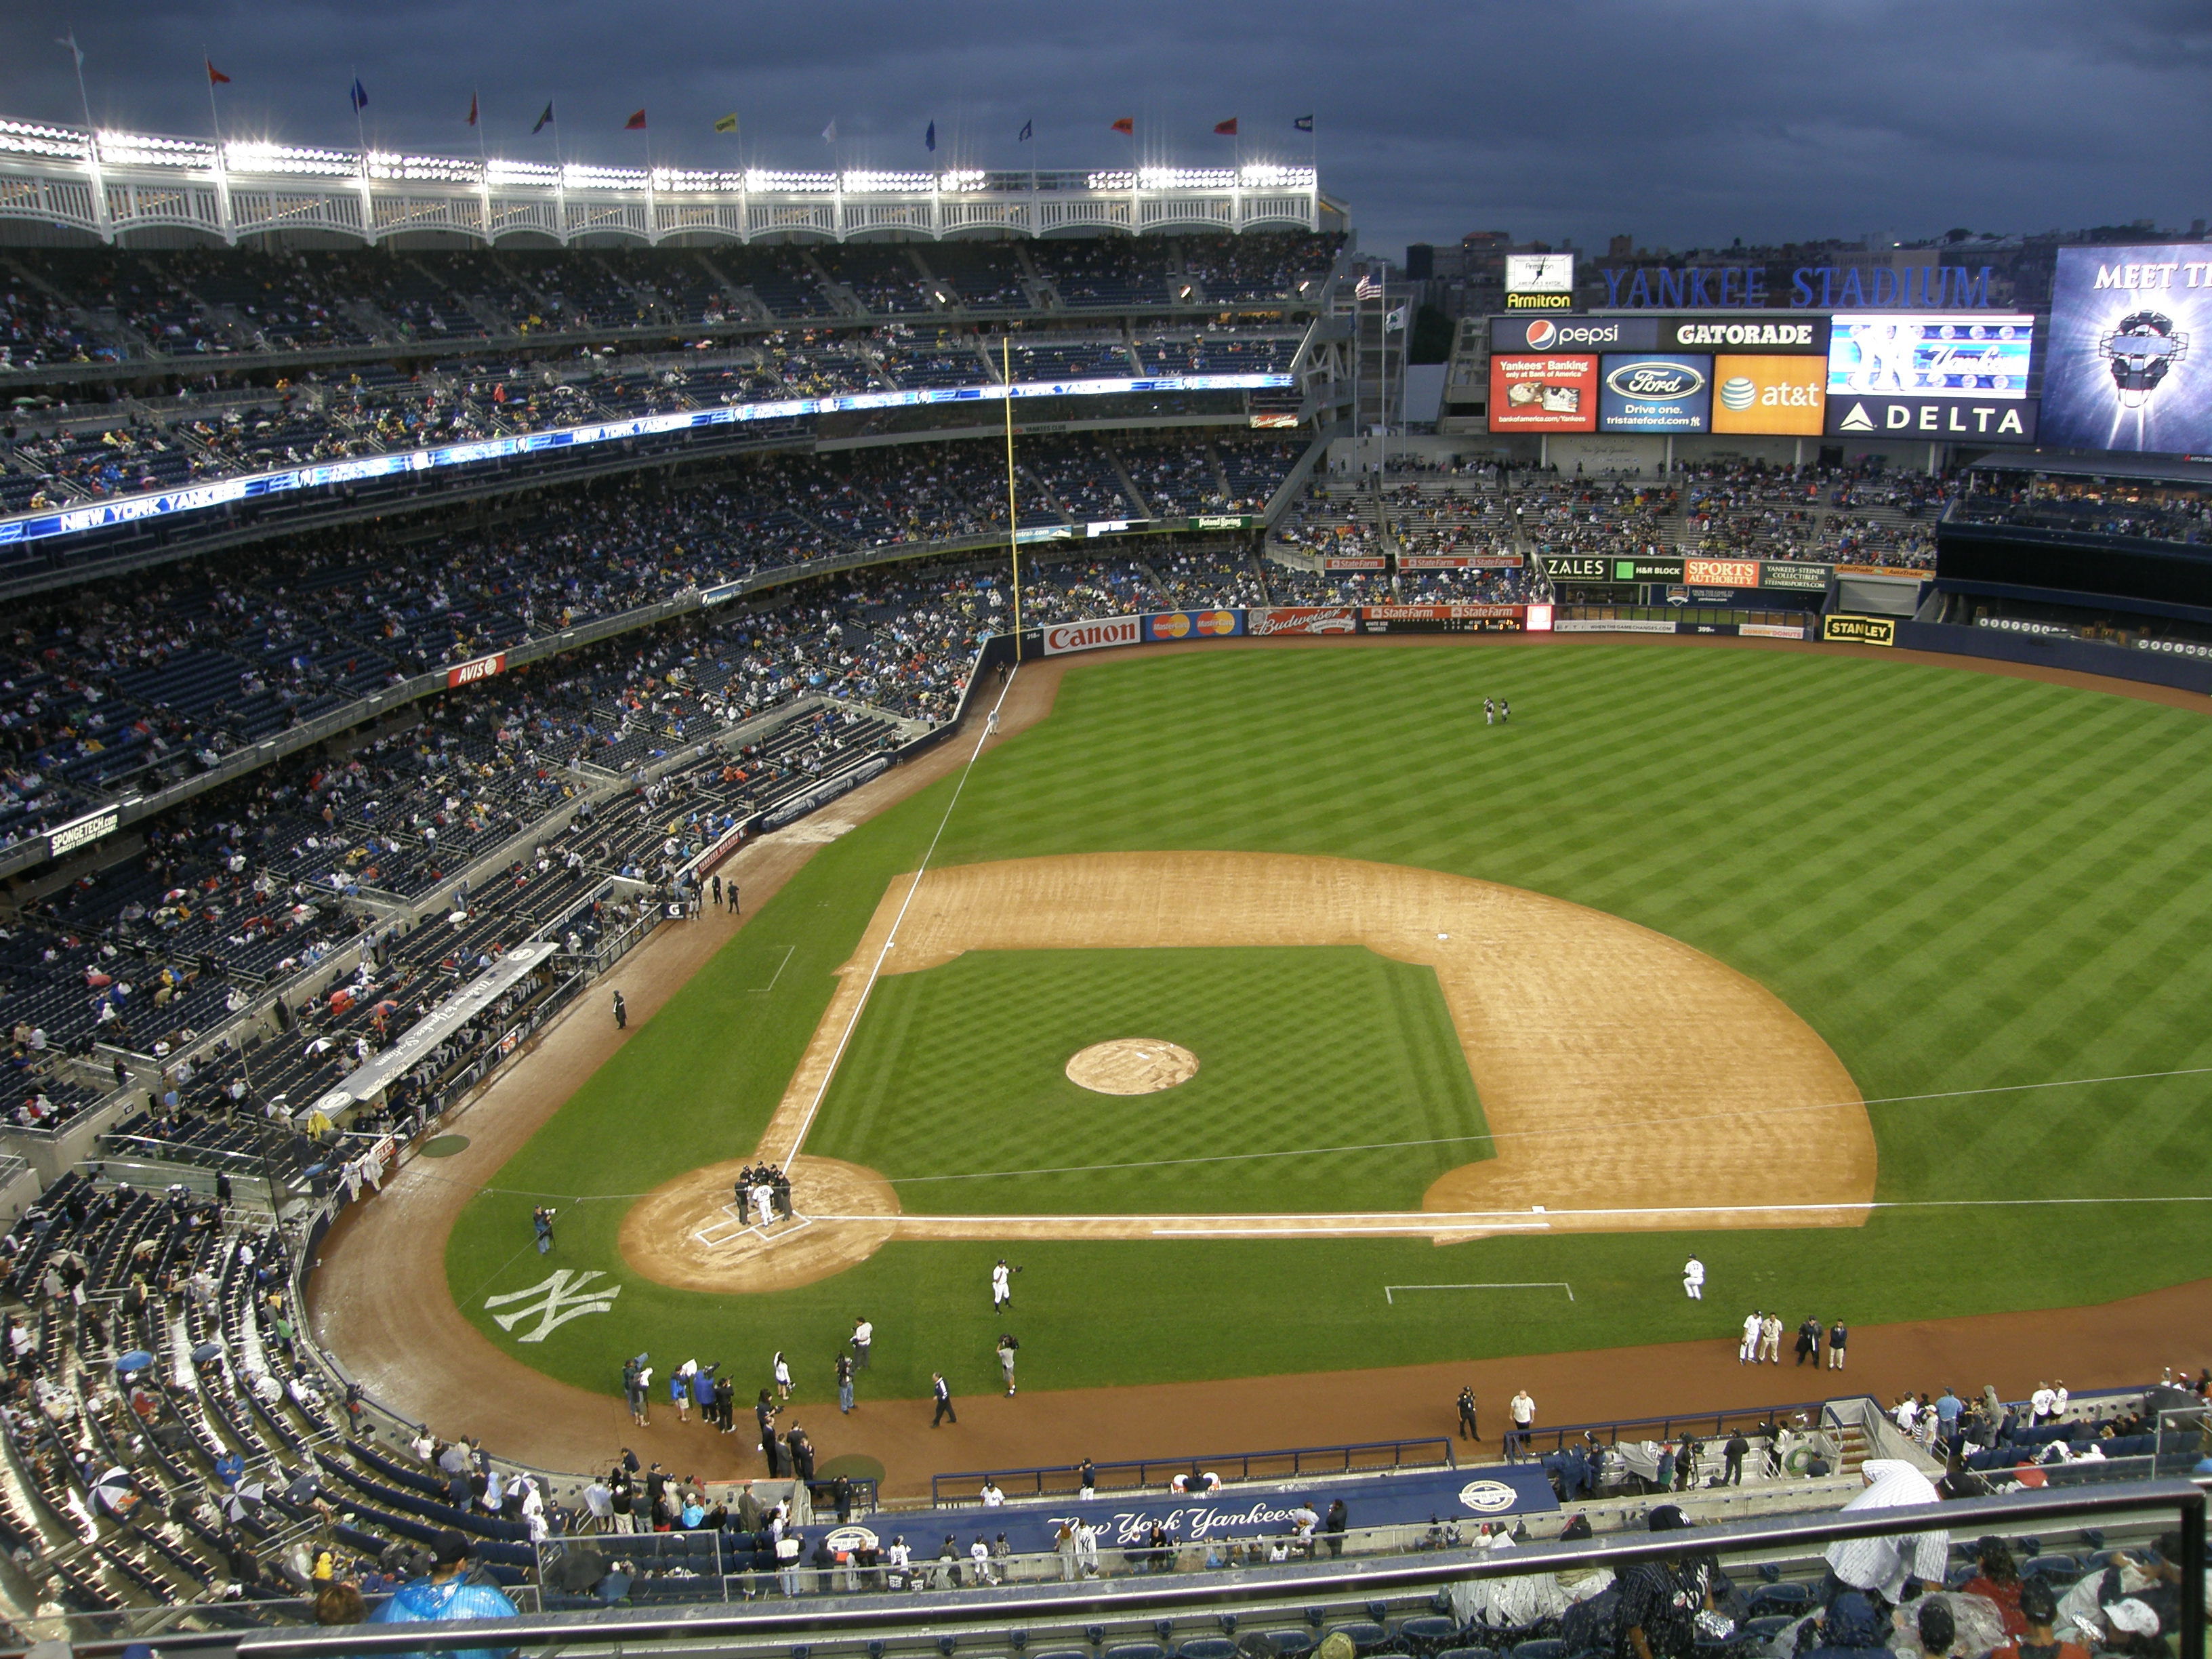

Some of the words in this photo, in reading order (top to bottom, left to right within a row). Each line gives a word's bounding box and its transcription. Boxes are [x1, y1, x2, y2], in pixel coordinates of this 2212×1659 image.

[2093, 263, 2179, 290] MEET
[1601, 268, 1765, 309] YANKEE
[1790, 266, 1993, 309] STADIUM
[1507, 293, 1571, 308] Armitron
[1559, 325, 1619, 346] pepsi
[1677, 325, 1812, 345] GATORADE
[1547, 360, 1589, 372] Banking
[1506, 371, 1519, 379] only
[1629, 369, 1682, 392] Ford
[1762, 382, 1819, 407] at&t
[1625, 405, 1656, 414] Drive
[1658, 406, 1683, 414] one.
[1498, 415, 1586, 424] bankofamerica.com/Yankees
[1606, 416, 1689, 425] tristateford.com
[1887, 405, 2024, 434] DELTA
[61, 507, 106, 531] NEW
[110, 498, 161, 521] YORK
[163, 480, 246, 511] YANKEES
[1199, 518, 1220, 527] Poland
[1221, 517, 1242, 527] Spring
[1548, 560, 1604, 575] ZALES
[1635, 567, 1653, 575] H&R
[1654, 567, 1680, 575] BLOCK
[1688, 562, 1755, 577] SPORTS
[1772, 571, 1819, 581] COLLECTIBLES
[1253, 607, 1341, 636] Budweiser
[1832, 621, 1887, 638] STANLEY
[1048, 622, 1136, 650] Canon
[1772, 629, 1801, 638] DONUTS
[458, 661, 485, 684] AVIS
[52, 813, 118, 850] SPONGETECH.com
[669, 903, 680, 916] G
[1186, 1502, 1296, 1538] Yankees
